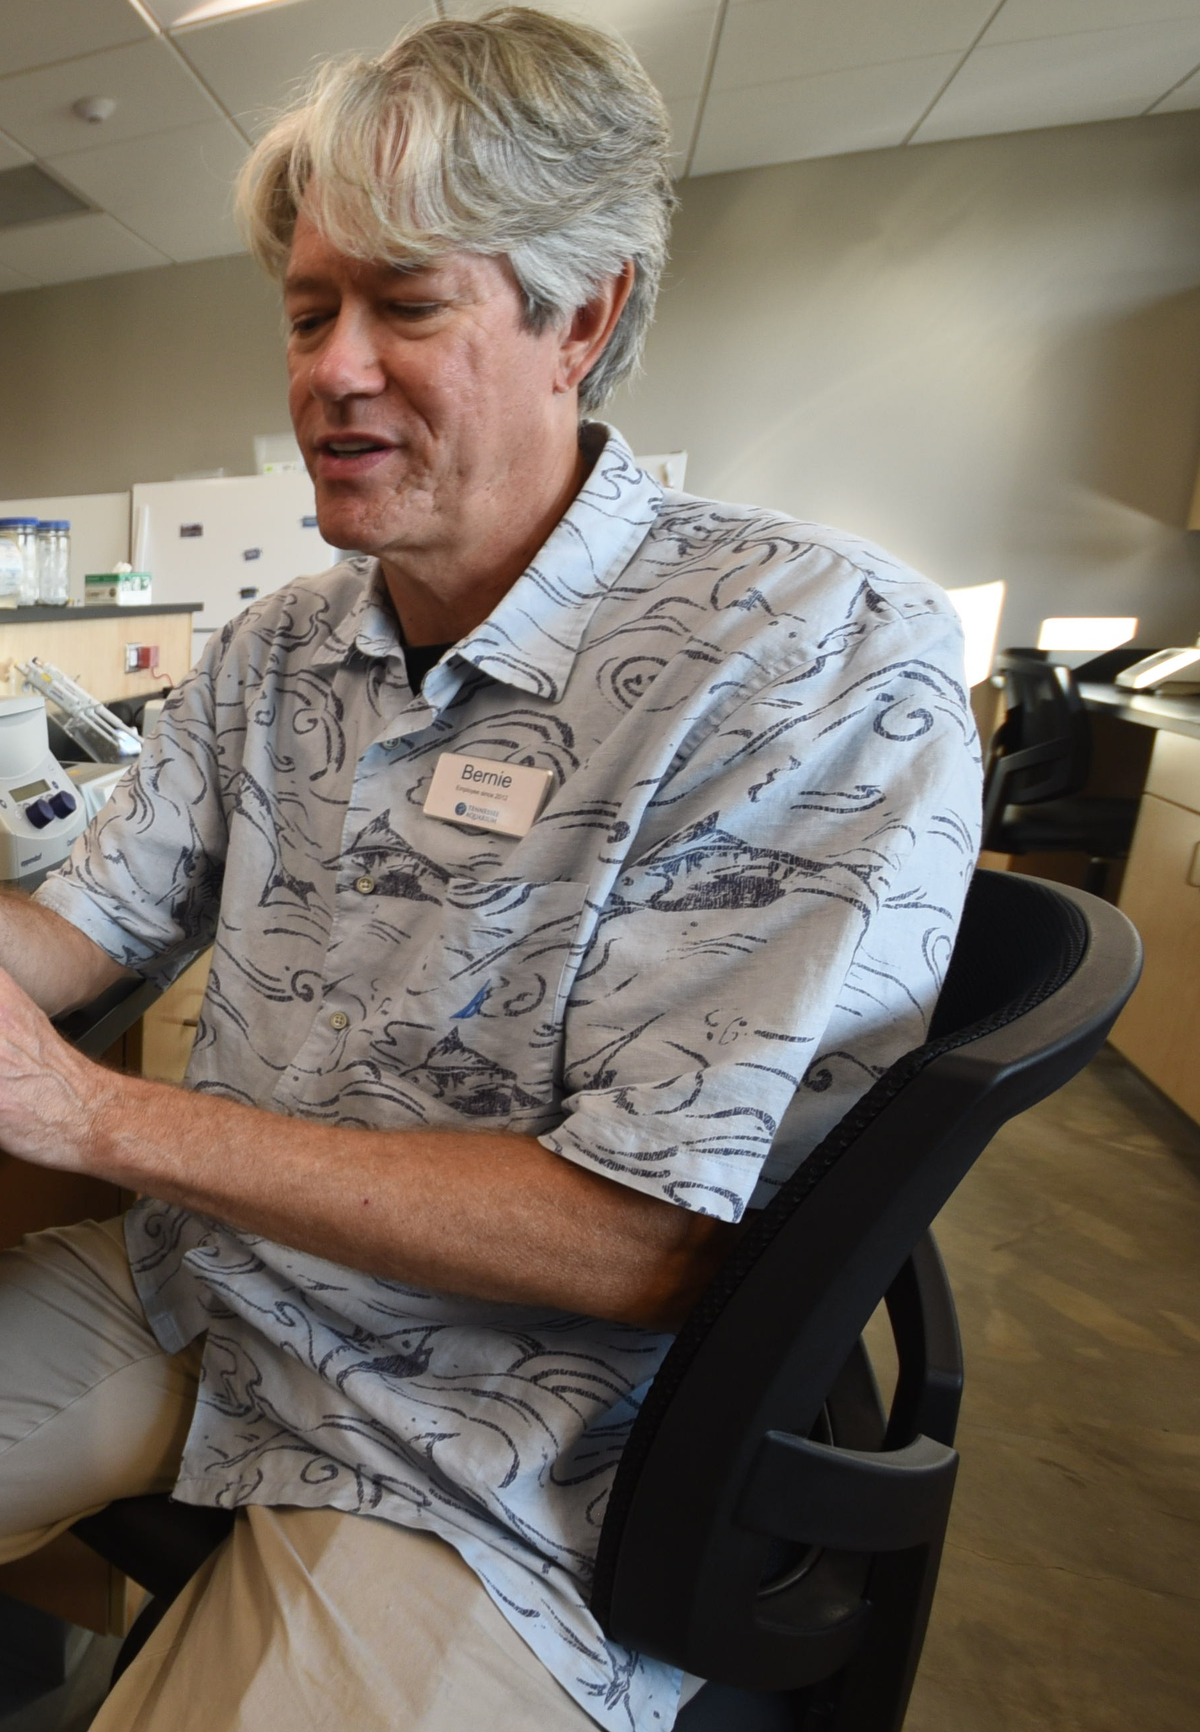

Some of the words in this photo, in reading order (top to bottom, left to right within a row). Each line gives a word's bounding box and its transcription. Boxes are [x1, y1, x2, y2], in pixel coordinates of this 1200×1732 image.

[461, 763, 513, 788] Bernie
[468, 804, 499, 817] TENNESSEE
[465, 812, 497, 823] AQUARIUM
